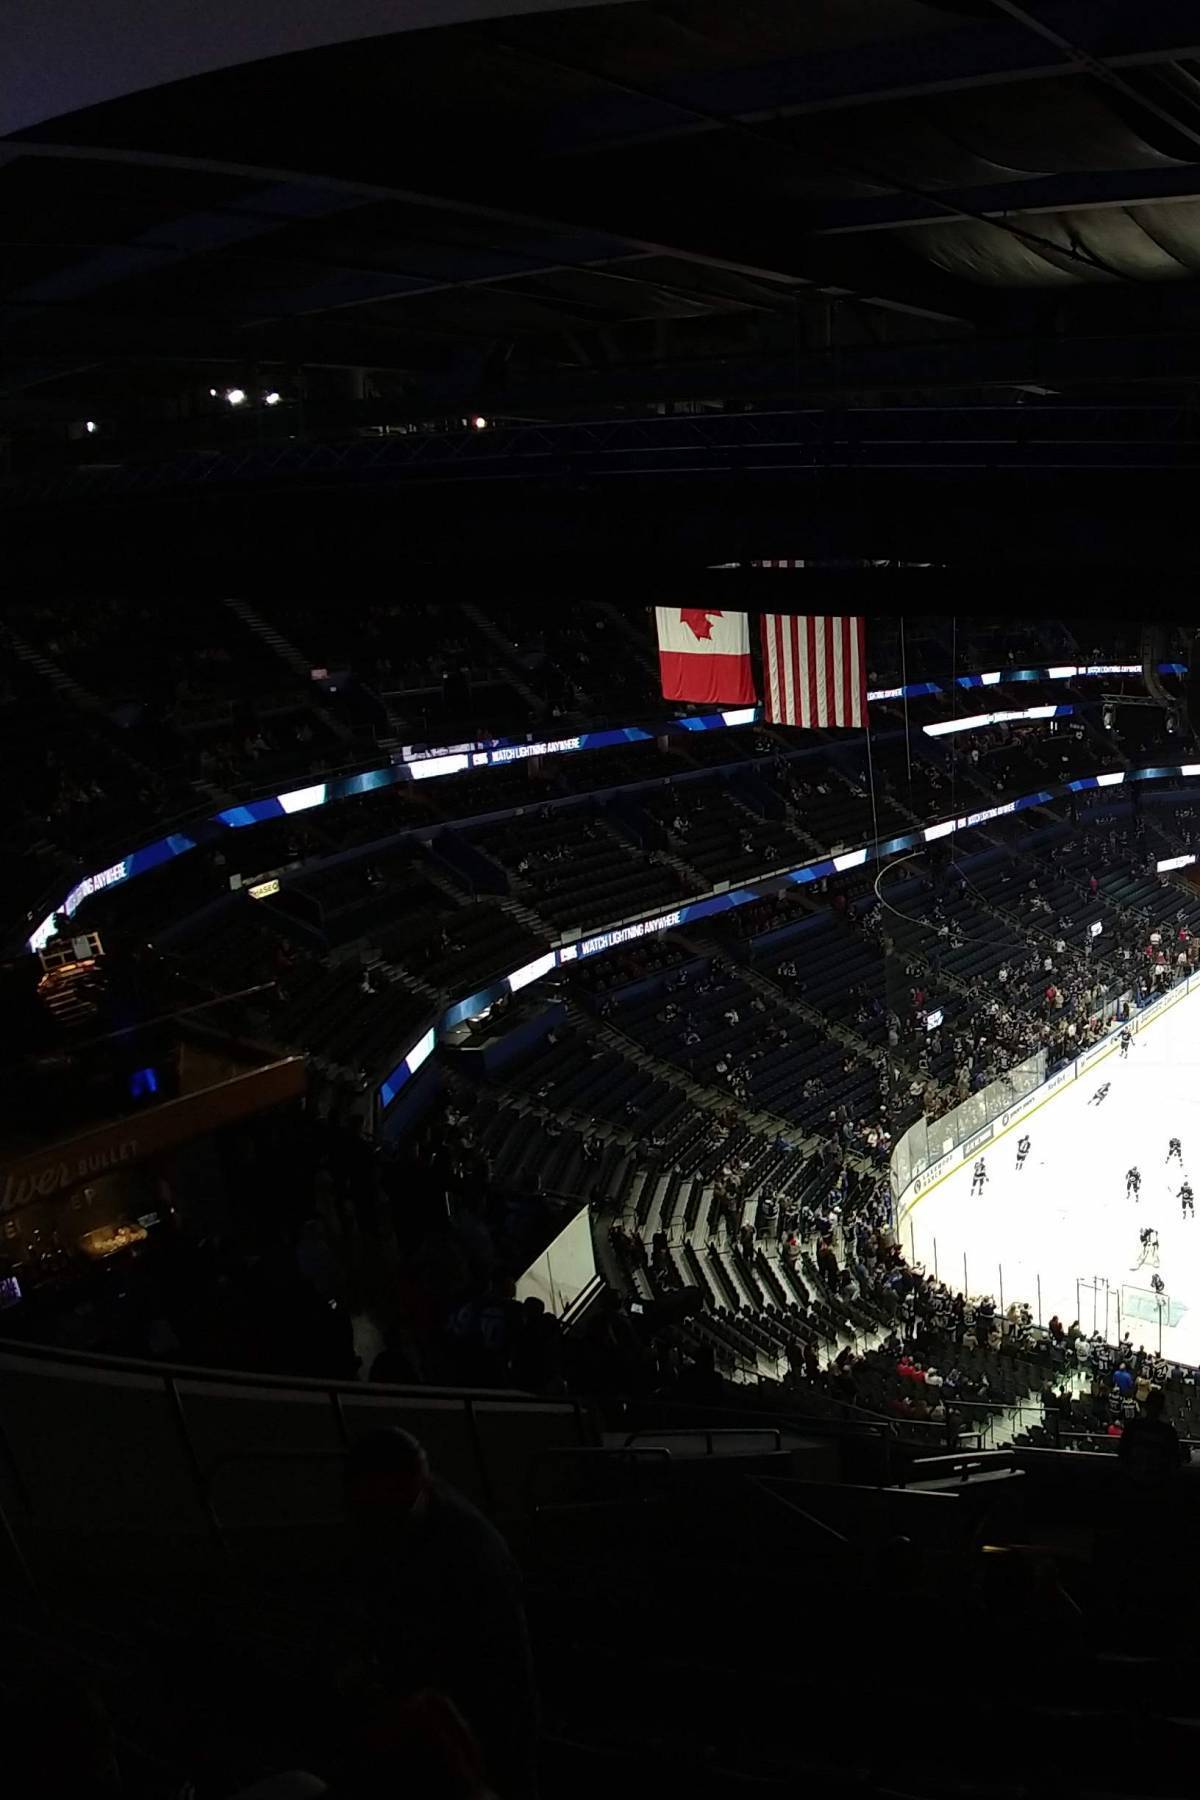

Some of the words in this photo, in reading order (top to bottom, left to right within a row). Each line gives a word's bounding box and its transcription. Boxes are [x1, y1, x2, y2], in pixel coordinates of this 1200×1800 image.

[581, 934, 609, 955] WATCH
[609, 923, 644, 947] LIGHTNING
[644, 910, 681, 934] ANYWHERE
